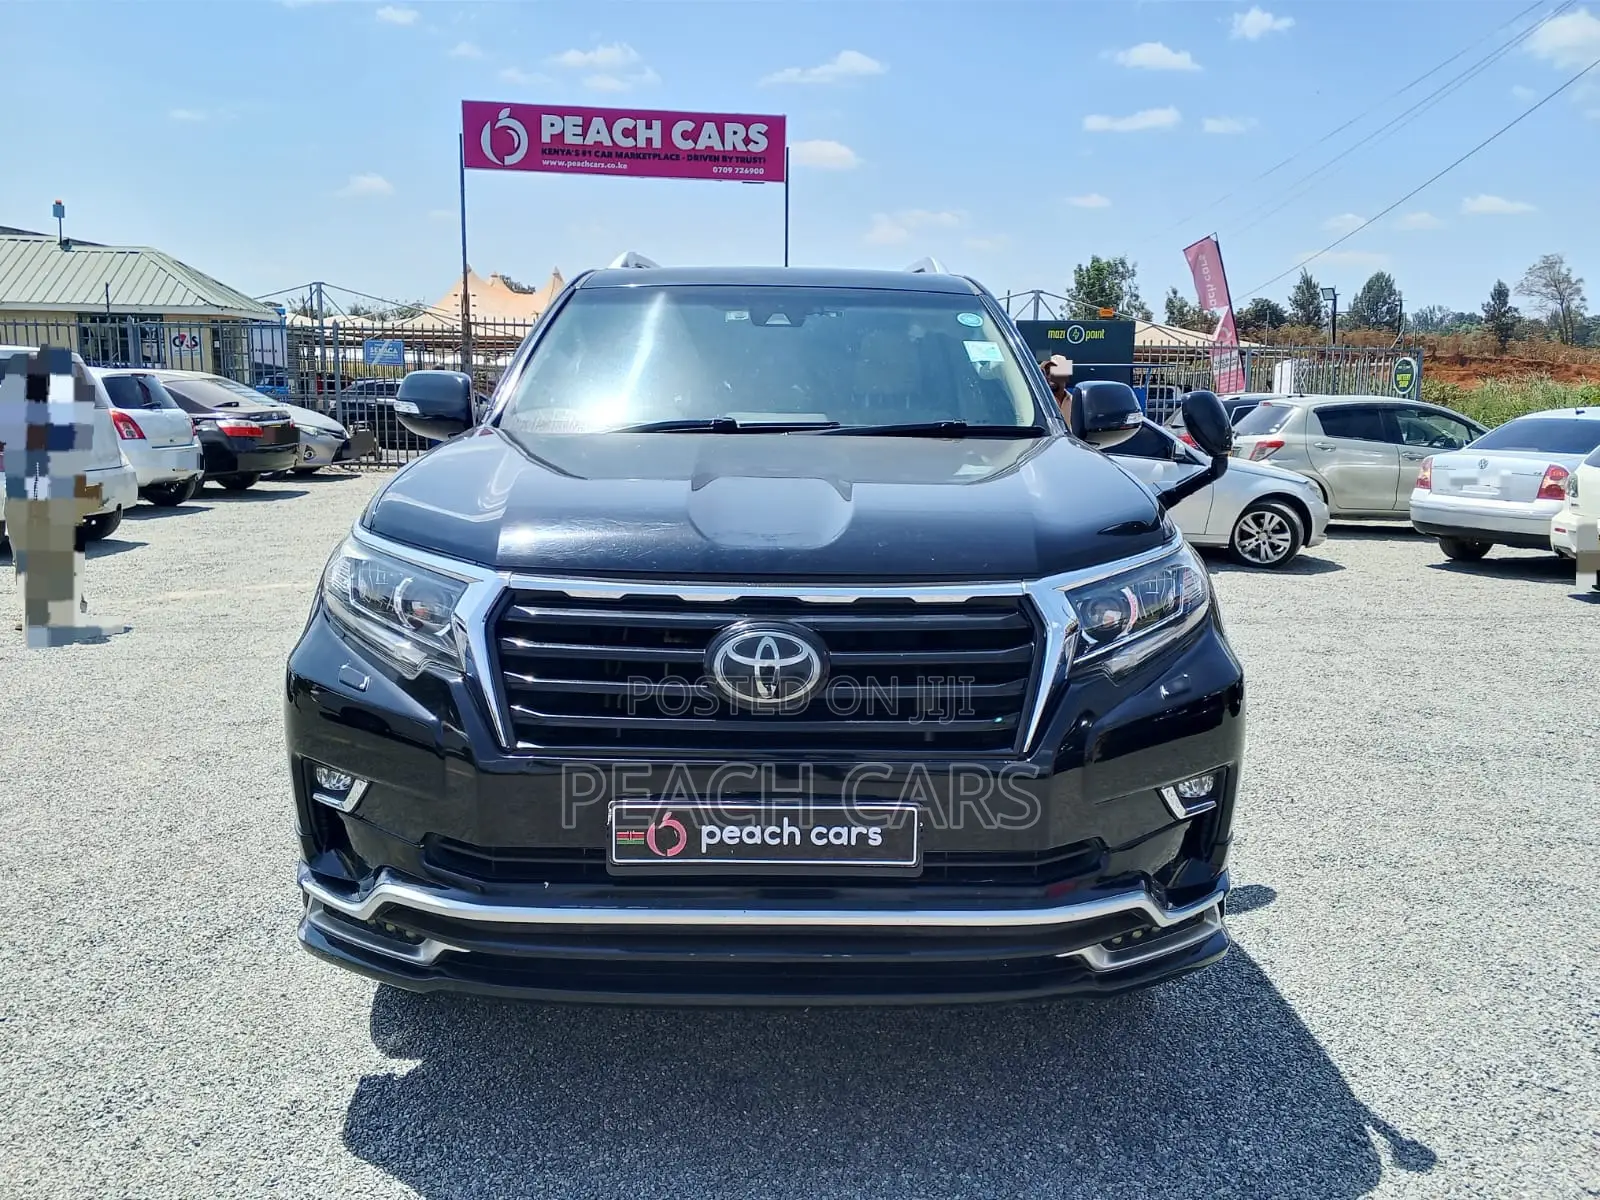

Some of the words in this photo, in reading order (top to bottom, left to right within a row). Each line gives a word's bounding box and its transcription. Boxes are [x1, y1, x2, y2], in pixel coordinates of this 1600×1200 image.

[541, 114, 662, 149] PEACH
[671, 120, 769, 153] CARS
[541, 147, 580, 157] KENYA'S
[594, 150, 613, 159] CAR
[615, 151, 680, 161] MARKETPLACE
[687, 154, 720, 163] DRIVEN
[722, 155, 733, 163] BY
[542, 159, 628, 169] www.peachcars.co.ke
[712, 166, 733, 174] 0709
[734, 167, 765, 175] 726900
[1047, 330, 1066, 339] mazi
[1085, 329, 1105, 342] point
[701, 816, 801, 854] peach
[810, 826, 883, 847] cars
